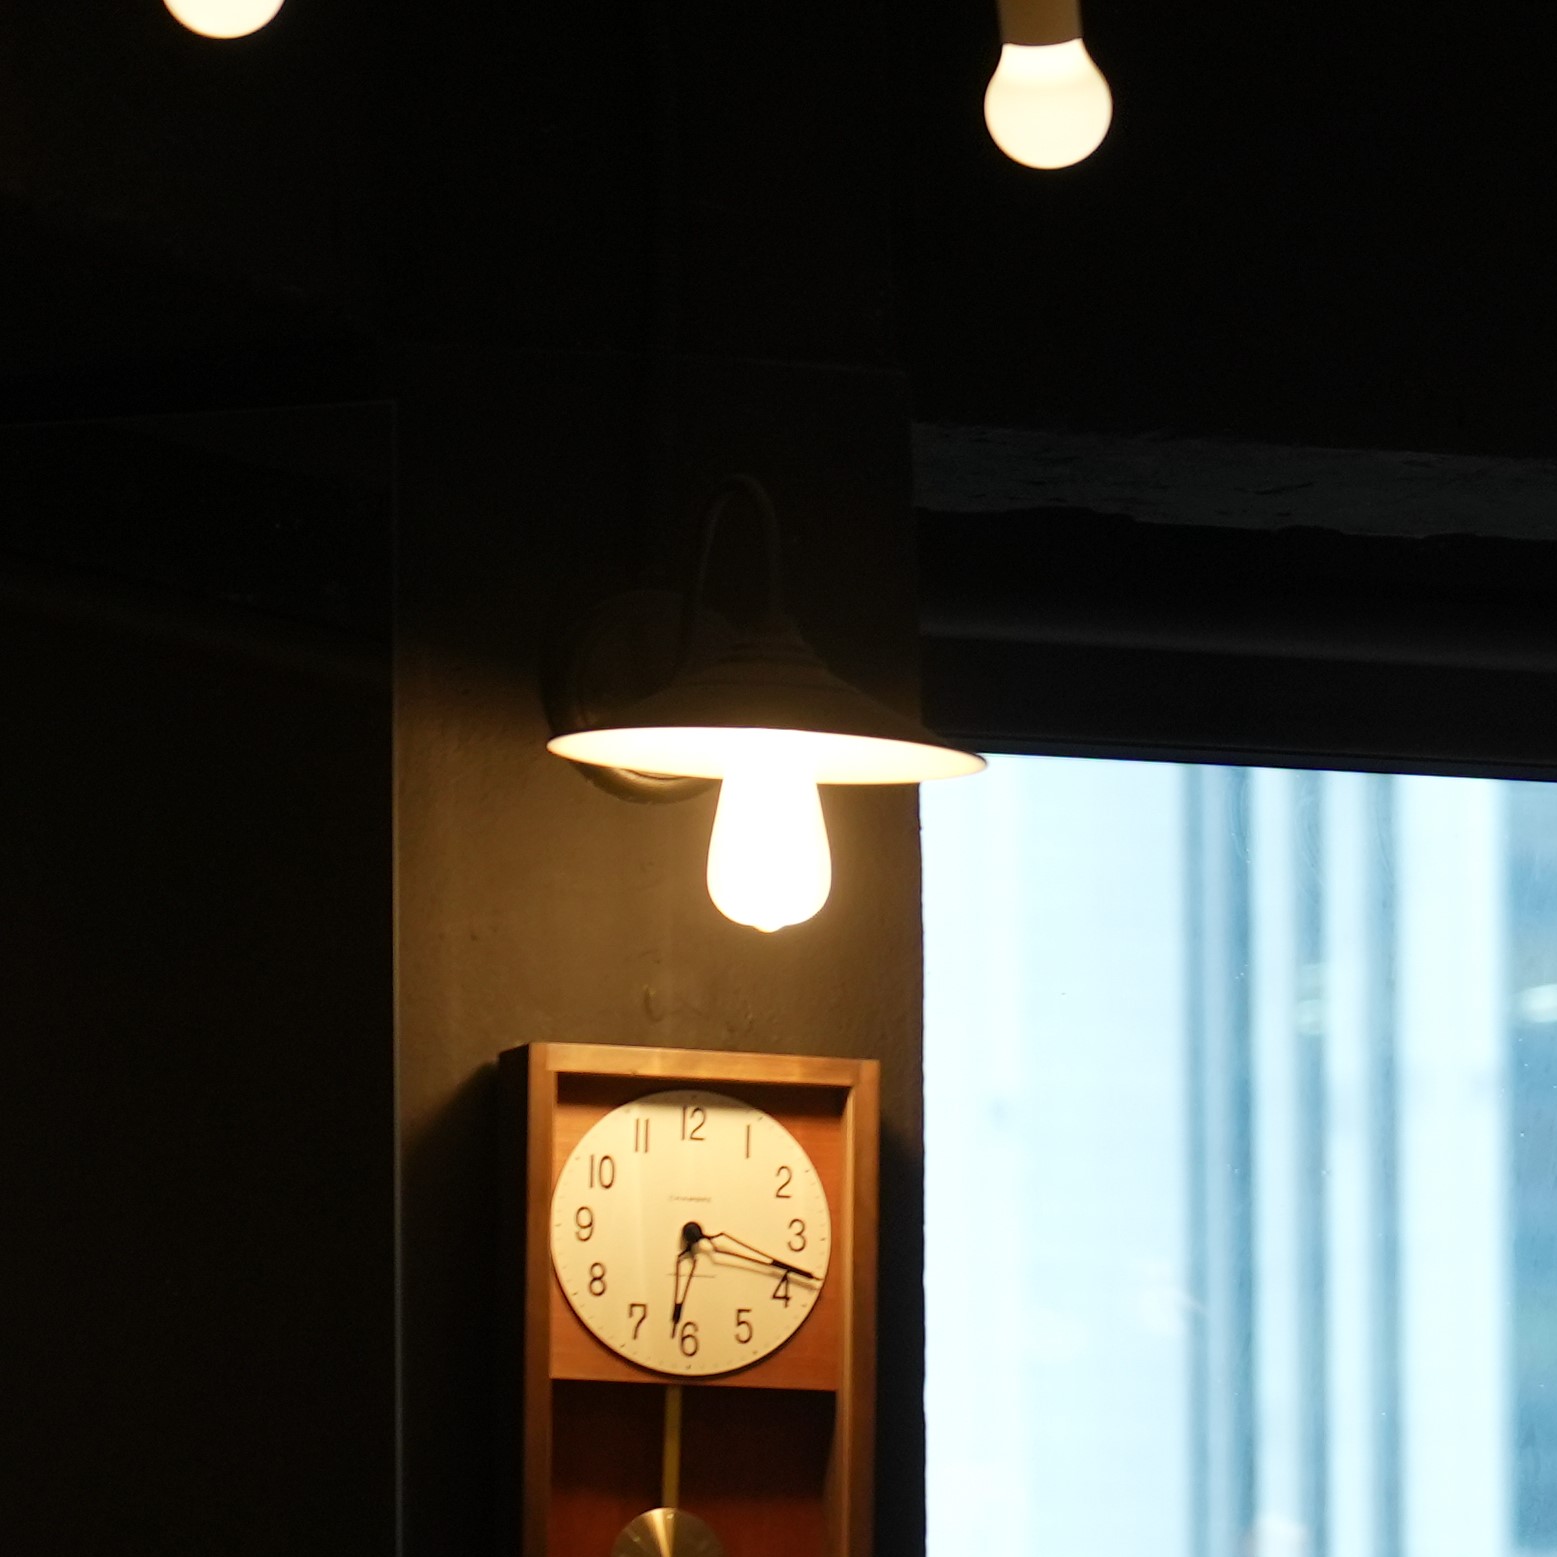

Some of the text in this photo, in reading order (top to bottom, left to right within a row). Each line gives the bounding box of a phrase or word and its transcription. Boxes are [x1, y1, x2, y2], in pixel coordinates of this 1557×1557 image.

[681, 1104, 707, 1141] 12
[588, 1153, 616, 1189] 10
[774, 1165, 793, 1199] 2
[574, 1205, 595, 1242] 9
[787, 1218, 807, 1252] 3
[588, 1262, 607, 1297] 8
[771, 1270, 794, 1308] 4
[628, 1303, 649, 1340] 7
[679, 1321, 700, 1358] 6
[734, 1308, 753, 1345] 5
